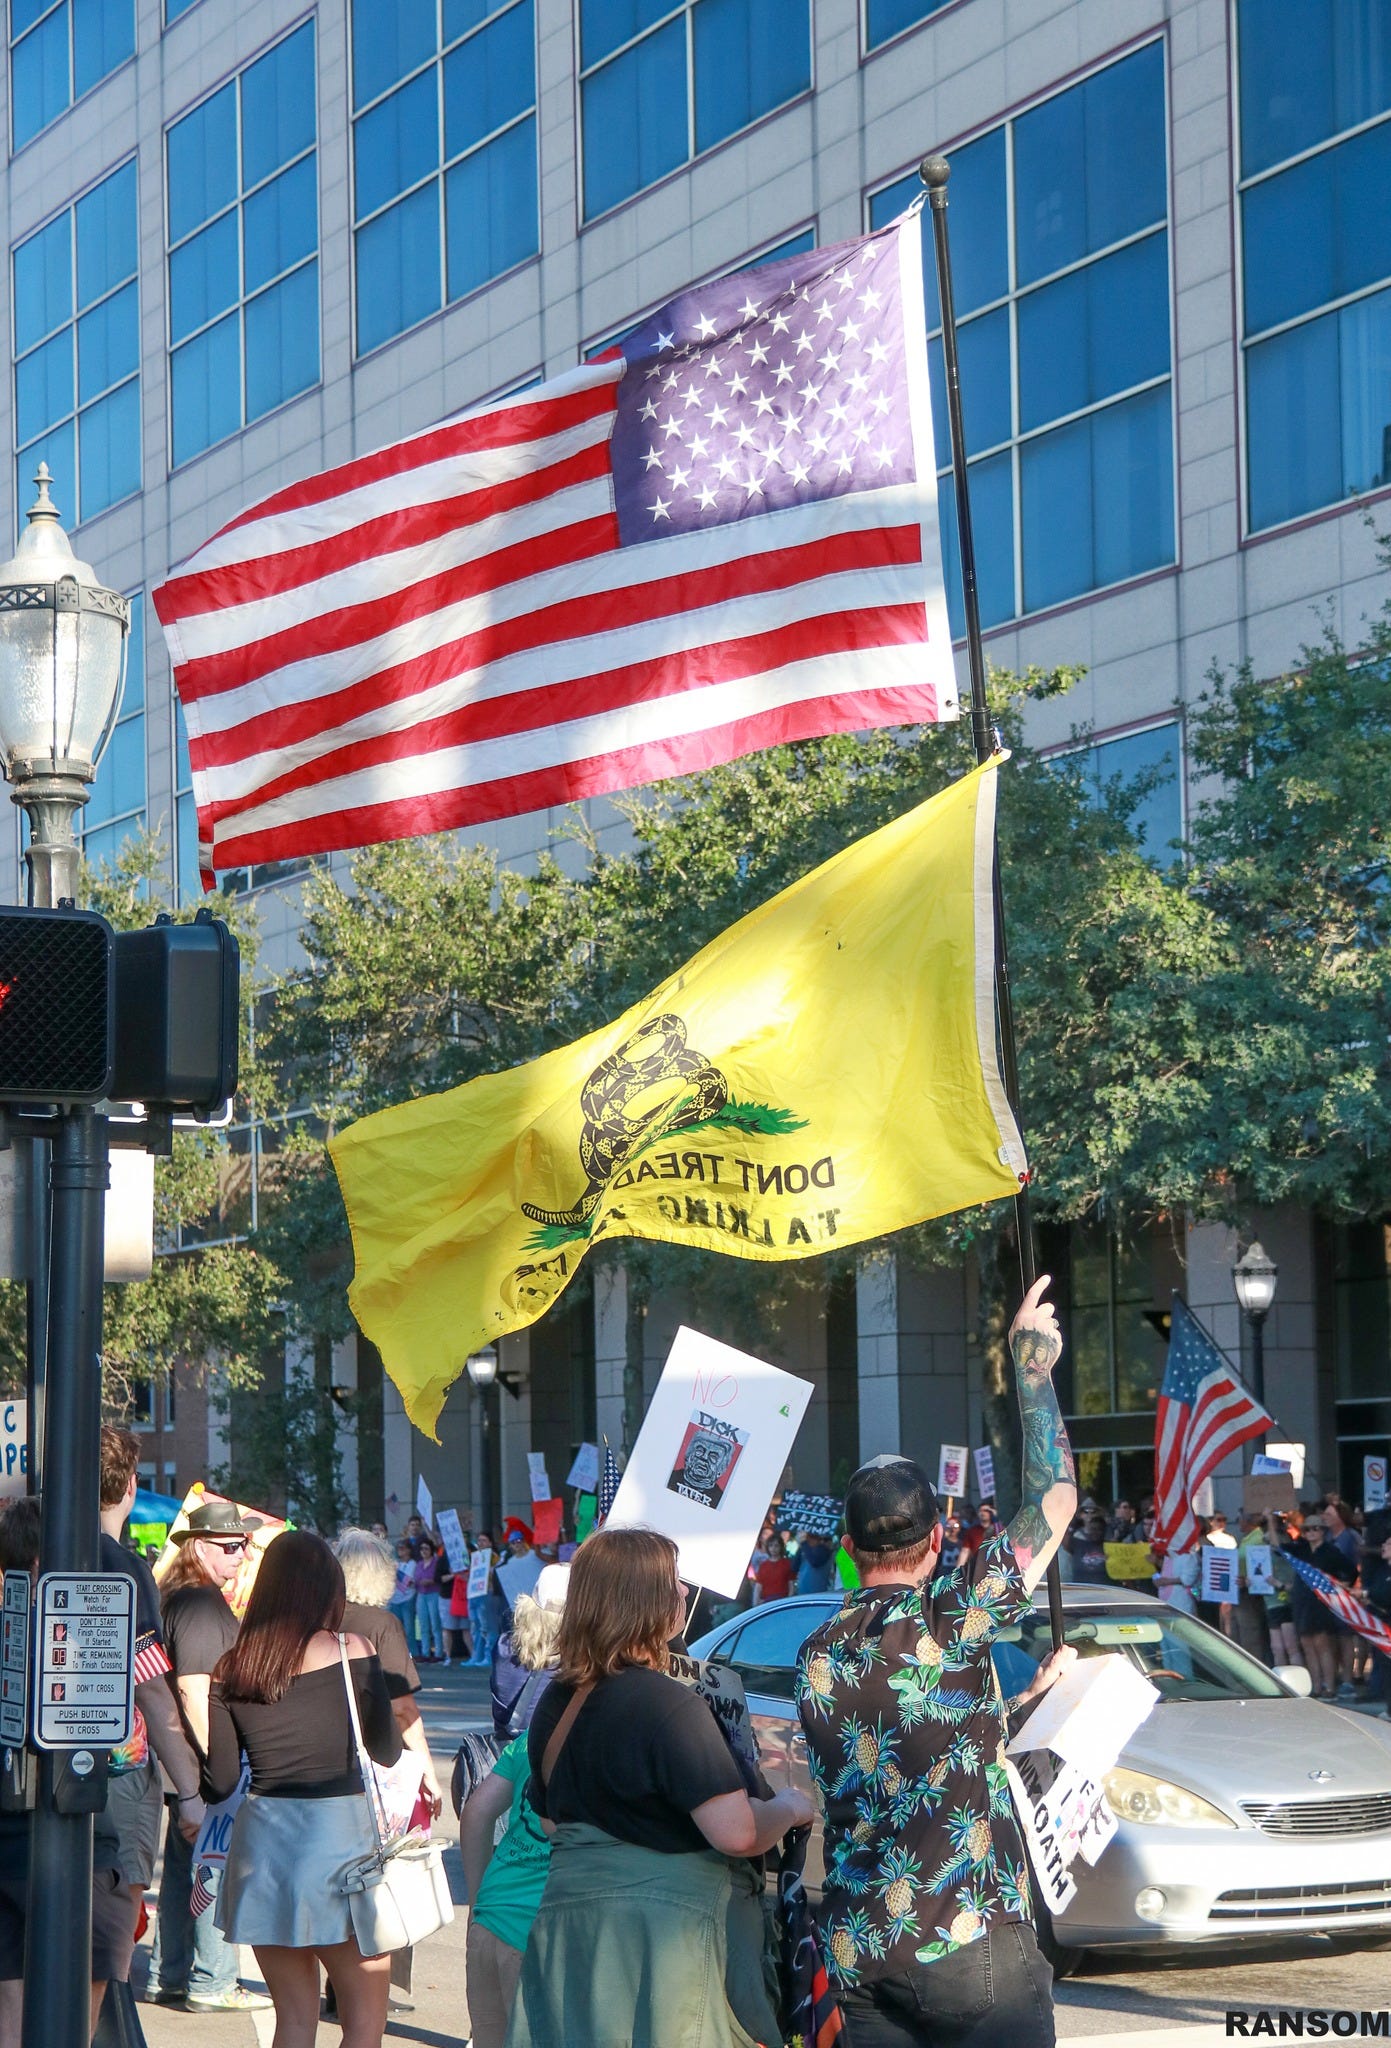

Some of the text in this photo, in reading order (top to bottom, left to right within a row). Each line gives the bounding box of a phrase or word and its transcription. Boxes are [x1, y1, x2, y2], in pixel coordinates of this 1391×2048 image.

[691, 1367, 739, 1408] NO
[698, 1410, 740, 1444] DICK
[76, 1584, 122, 1593] START CROSSING
[83, 1595, 111, 1604] Watch For
[86, 1604, 108, 1613] Vehicles
[80, 1618, 117, 1626] DON'T START
[77, 1629, 118, 1638] Finish Crossing
[92, 1638, 111, 1646] Started
[73, 1650, 122, 1659] TIME REMAINING
[72, 1660, 122, 1670] To Finish Crossing
[76, 1684, 115, 1693] DON'T CROSS
[59, 1710, 108, 1718] PUSH BUTTON
[65, 1726, 100, 1734] TO CROSS
